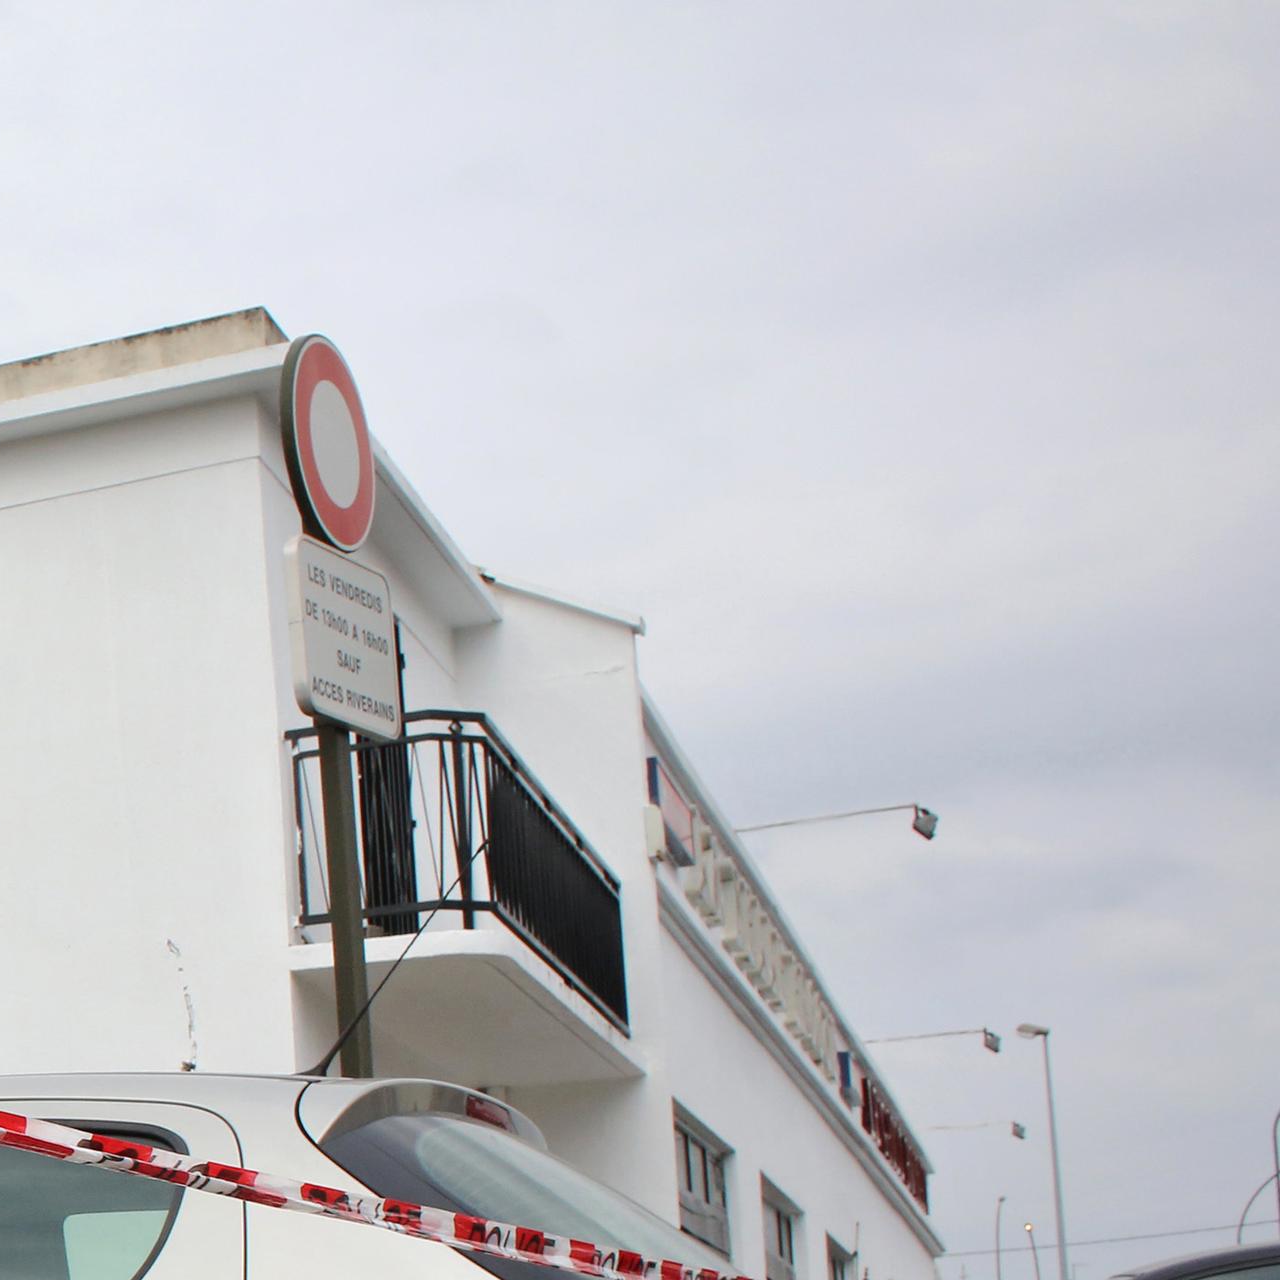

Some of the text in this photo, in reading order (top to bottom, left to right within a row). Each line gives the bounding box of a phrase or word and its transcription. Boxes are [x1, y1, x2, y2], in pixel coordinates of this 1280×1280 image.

[307, 563, 383, 614] LES VENDREDIS
[305, 599, 318, 620] DE
[352, 624, 359, 641] A
[336, 649, 361, 675] SAUF
[311, 676, 396, 723] ACCES RIVERAINS
